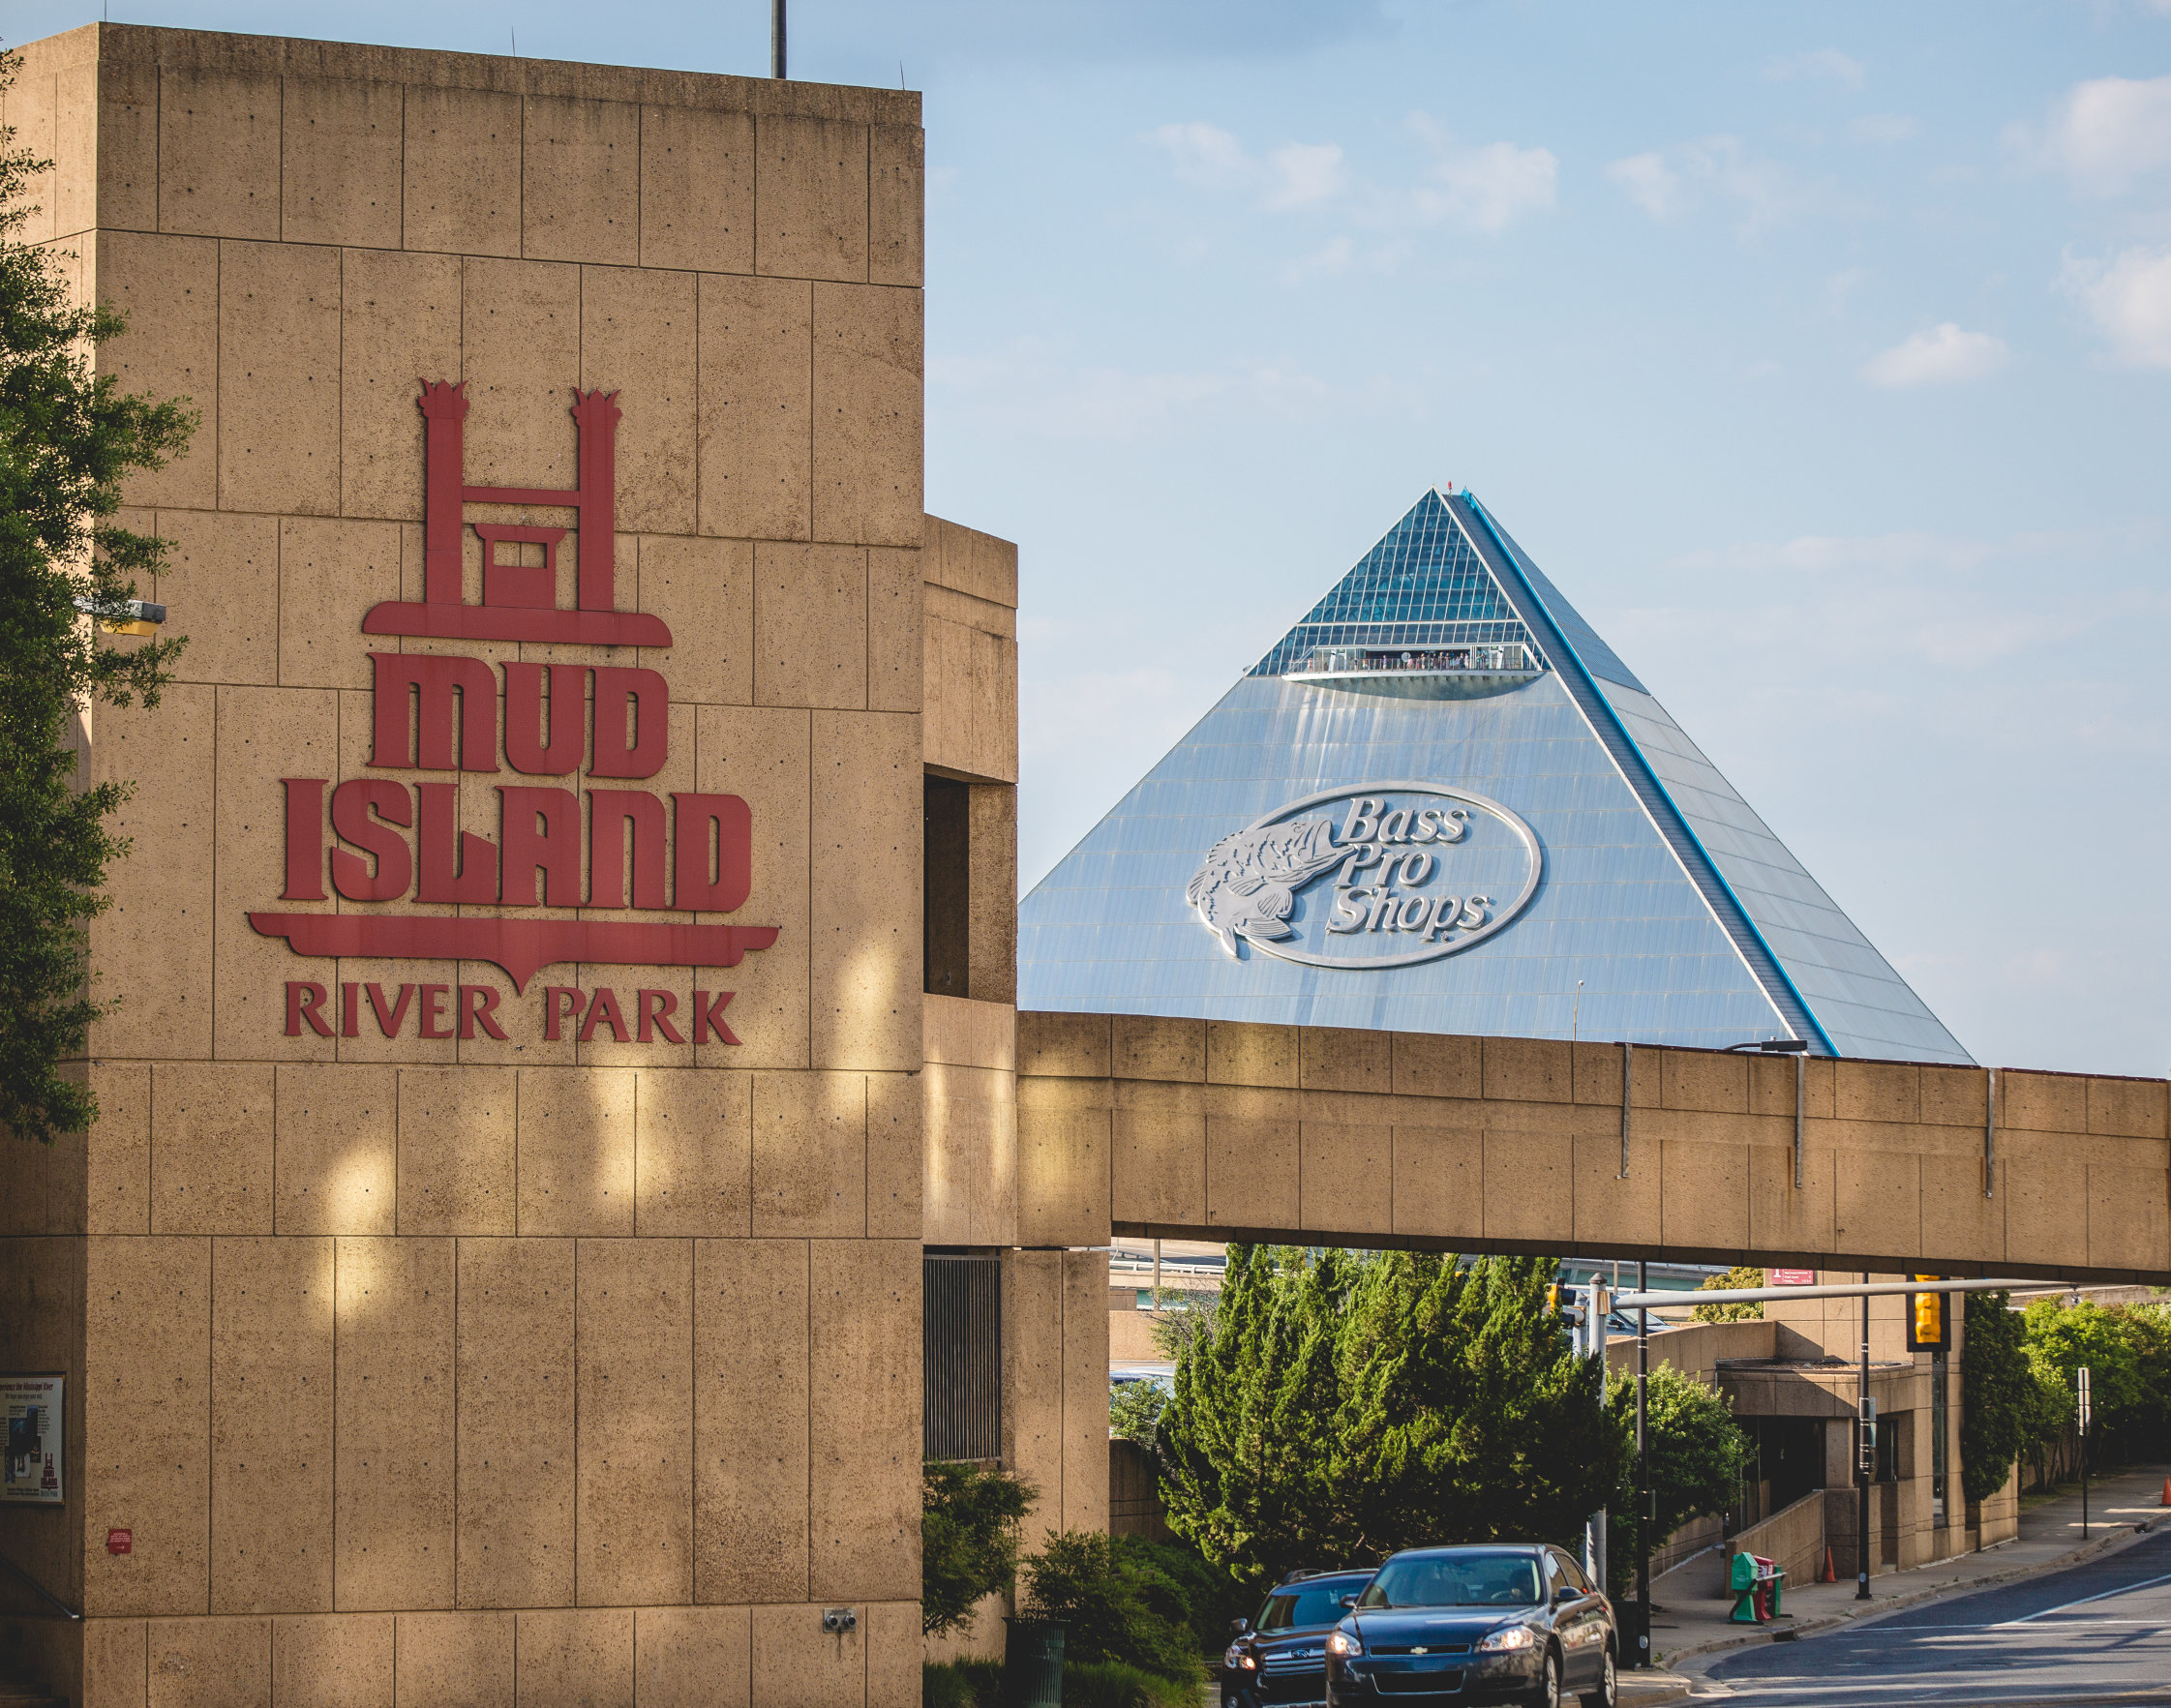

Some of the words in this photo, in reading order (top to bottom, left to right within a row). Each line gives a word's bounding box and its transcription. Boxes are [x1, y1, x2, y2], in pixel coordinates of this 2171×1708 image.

[366, 652, 669, 779] MUD
[279, 778, 752, 912] ISLAND
[1334, 796, 1471, 844] Bass
[1332, 843, 1434, 887] Pro
[1325, 886, 1490, 942] Shops
[285, 981, 509, 1040] RIVER
[544, 986, 743, 1046] PARK
